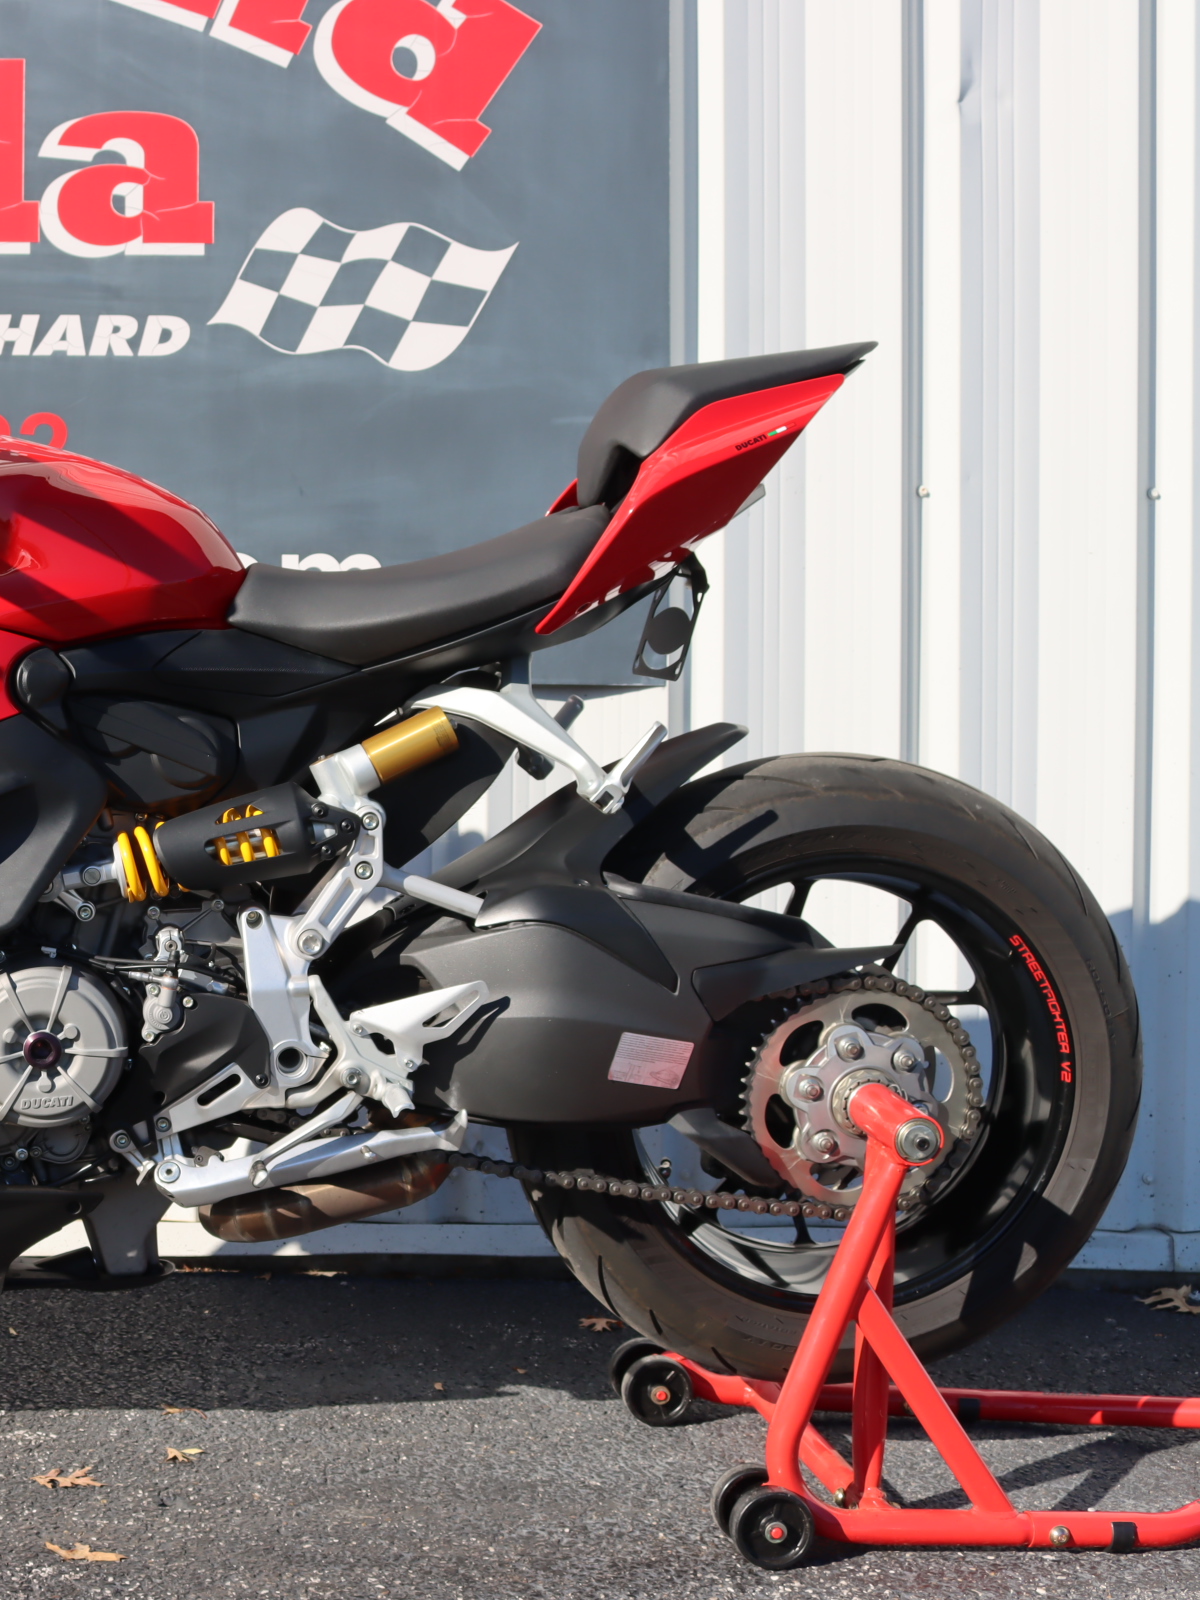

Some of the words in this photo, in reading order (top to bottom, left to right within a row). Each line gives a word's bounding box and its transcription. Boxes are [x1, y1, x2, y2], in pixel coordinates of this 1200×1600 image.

[735, 434, 767, 451] DUCATI
[1009, 934, 1071, 1054] STREETFIGHTER
[1060, 1061, 1072, 1083] V2
[21, 1096, 74, 1110] DUCATI
